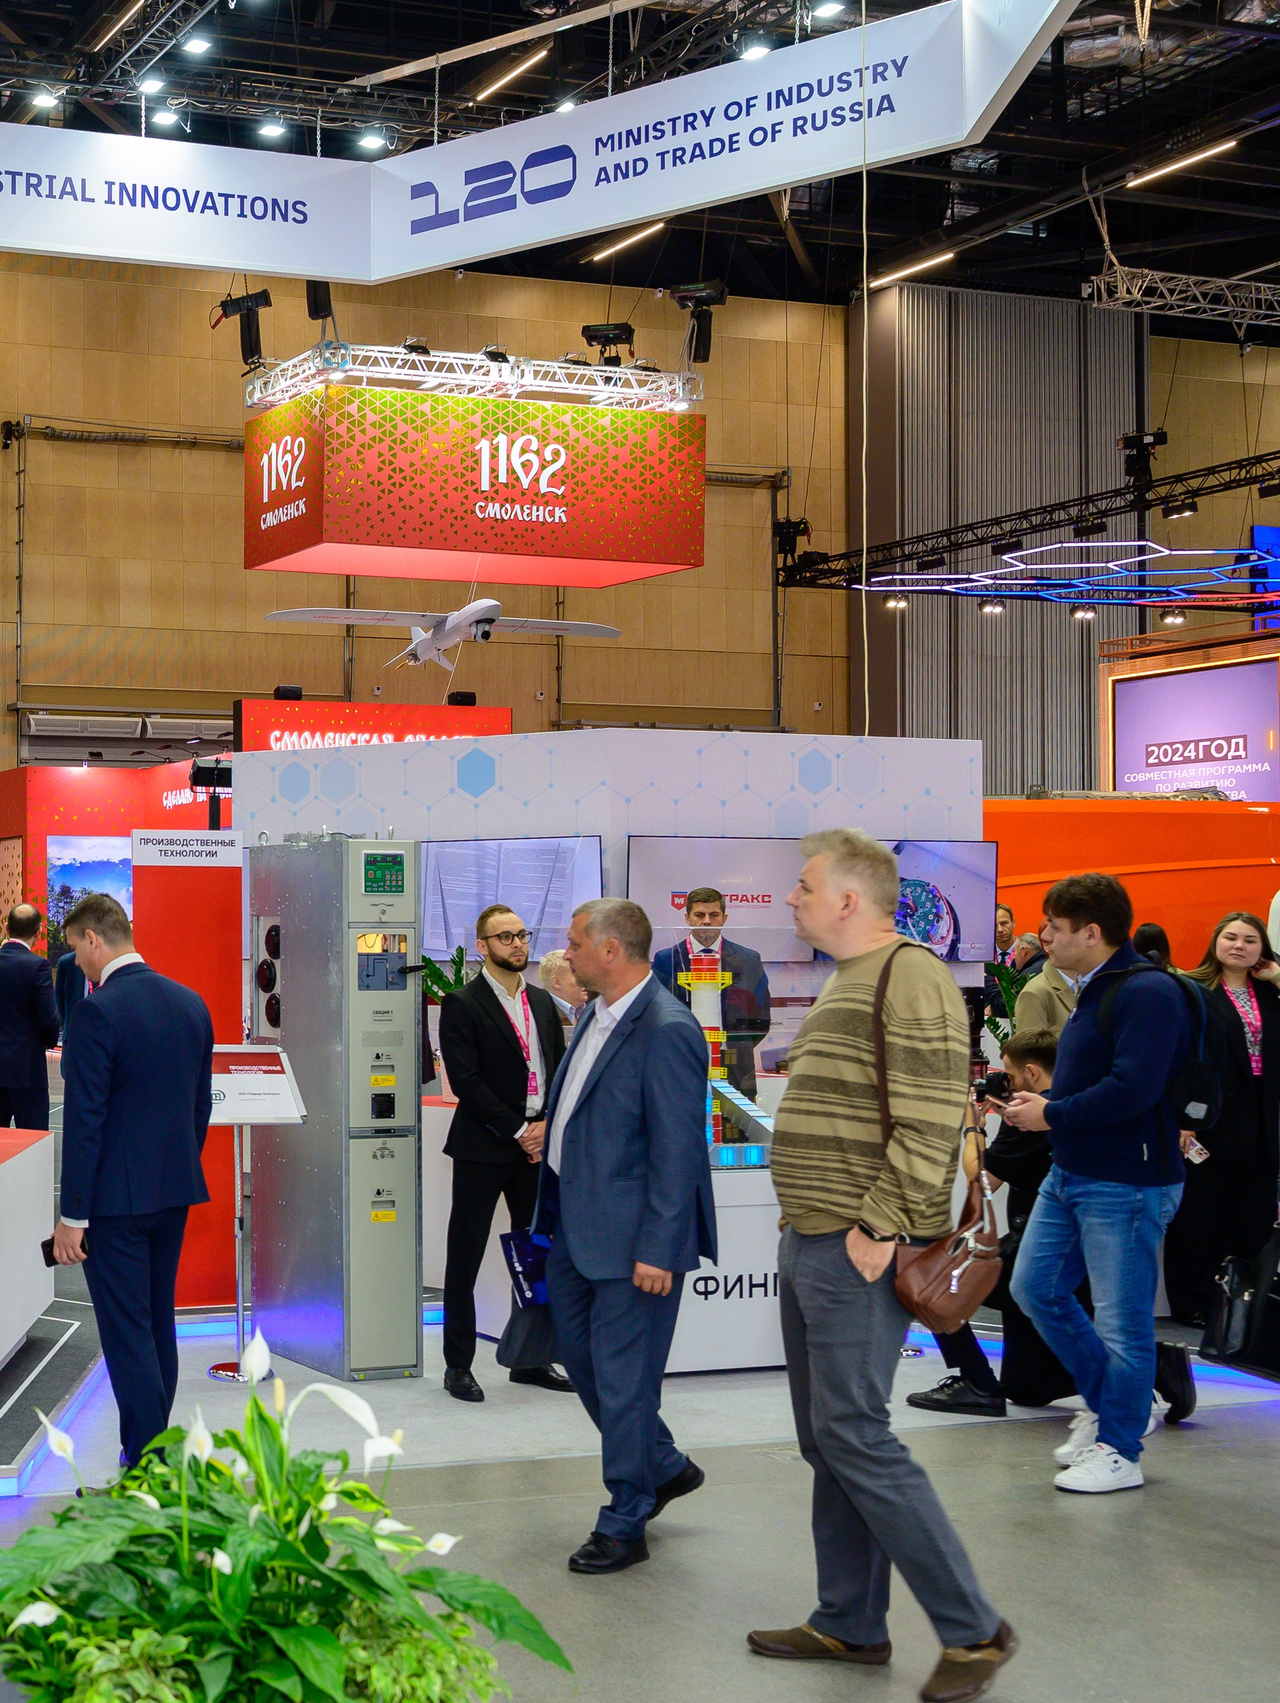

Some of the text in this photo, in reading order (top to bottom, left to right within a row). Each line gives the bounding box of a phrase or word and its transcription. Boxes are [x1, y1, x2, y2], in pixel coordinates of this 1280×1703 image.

[594, 55, 910, 157] MINISTRY OF INDUSTRY
[594, 93, 896, 188] AND TRADE OF RUSSIA
[104, 180, 308, 225] INNOVATIONS
[410, 144, 577, 236] 120
[260, 434, 305, 504] 1162
[475, 432, 567, 496] 1162
[260, 497, 306, 531] СМОЛЕНСК
[475, 501, 567, 524] СМОЛЕНСК
[1124, 762, 1271, 783] СОВМЕСТНАЯ ПРОГРАММА
[1155, 783, 1171, 793] ПО
[139, 837, 236, 847] ПРОИЗВОДСТВЕННЫЕ
[158, 849, 218, 858] ТЕХНОЛОГИИ
[723, 894, 772, 904] ТРАКС
